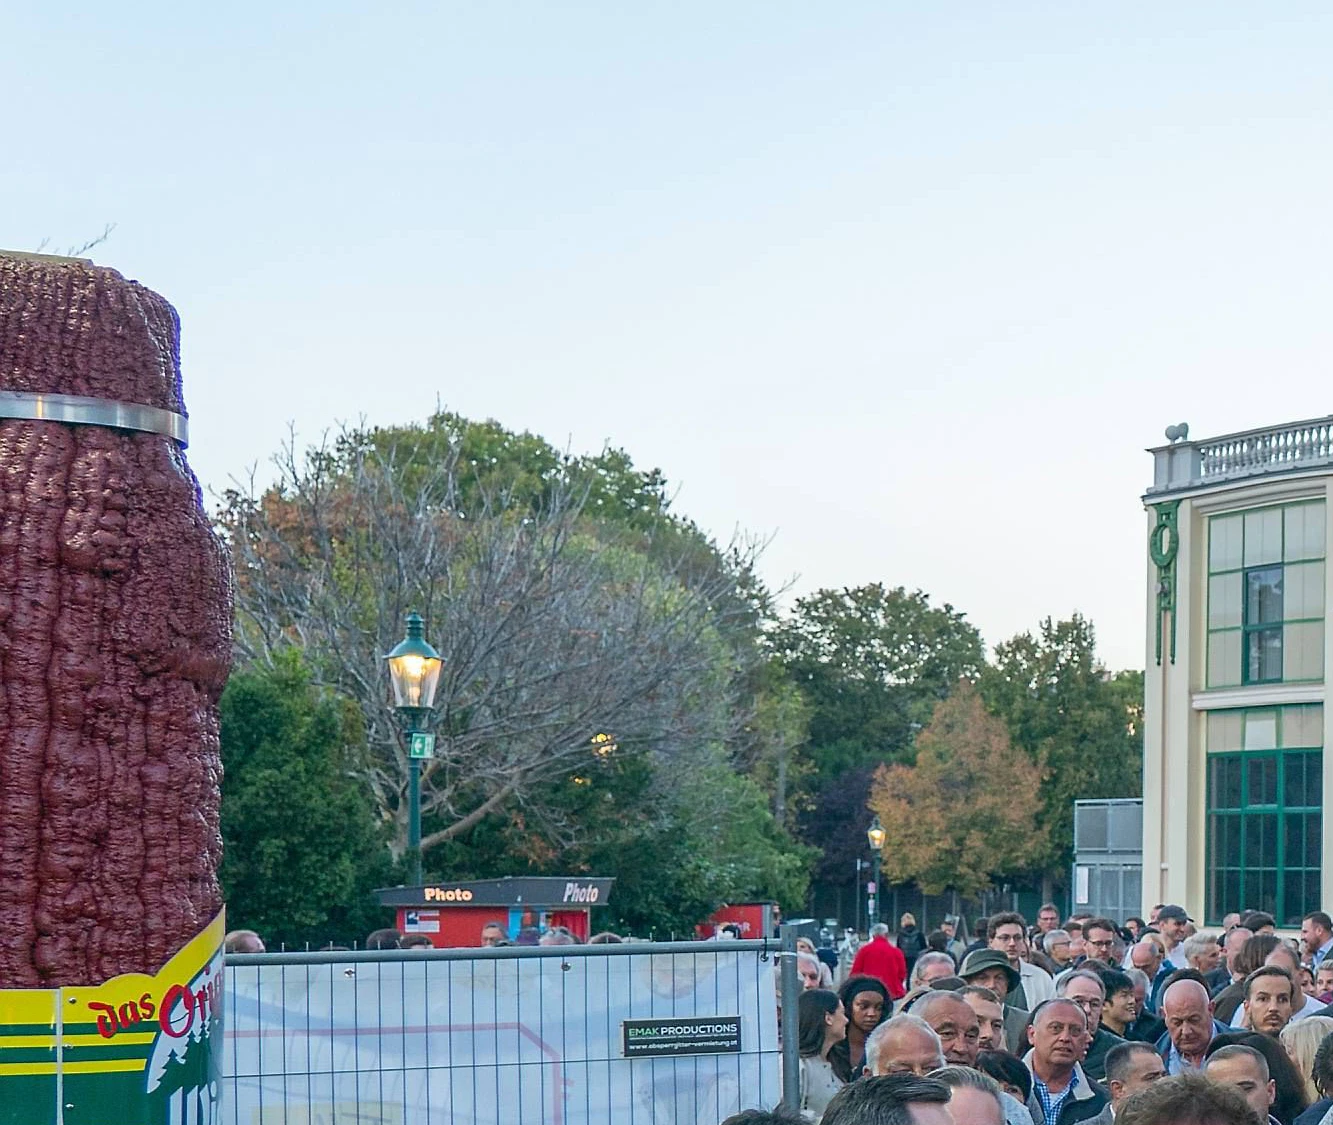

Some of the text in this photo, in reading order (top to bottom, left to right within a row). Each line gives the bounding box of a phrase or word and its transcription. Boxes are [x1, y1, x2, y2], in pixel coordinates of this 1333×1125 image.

[424, 887, 472, 901] Photo
[562, 882, 599, 902] Photo
[88, 993, 155, 1039] das
[629, 1027, 659, 1037] EMAK
[660, 1023, 737, 1035] PRODUCTIONS
